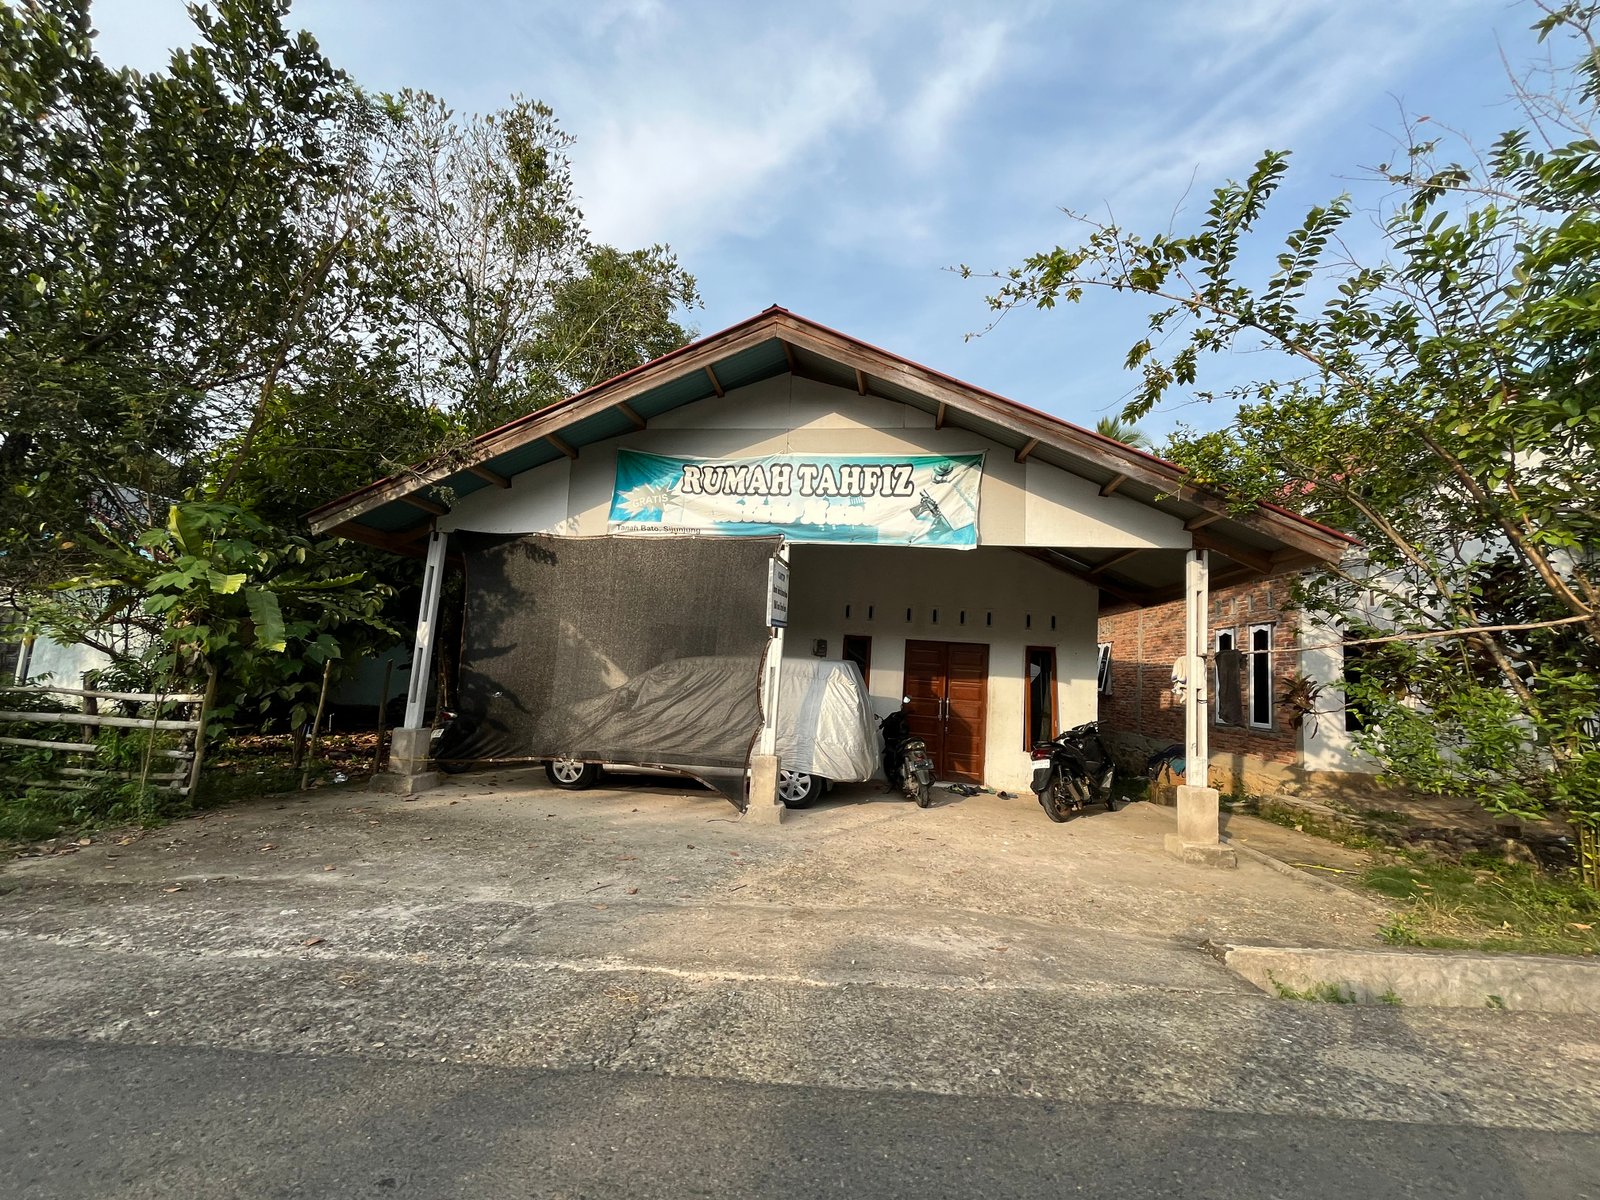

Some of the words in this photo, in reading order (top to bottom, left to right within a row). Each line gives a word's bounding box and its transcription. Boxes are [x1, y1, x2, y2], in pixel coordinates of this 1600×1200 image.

[681, 463, 794, 497] RUMAH
[797, 463, 914, 498] TAHFIZ
[632, 493, 669, 508] GRATIS
[616, 523, 639, 532] Tanah
